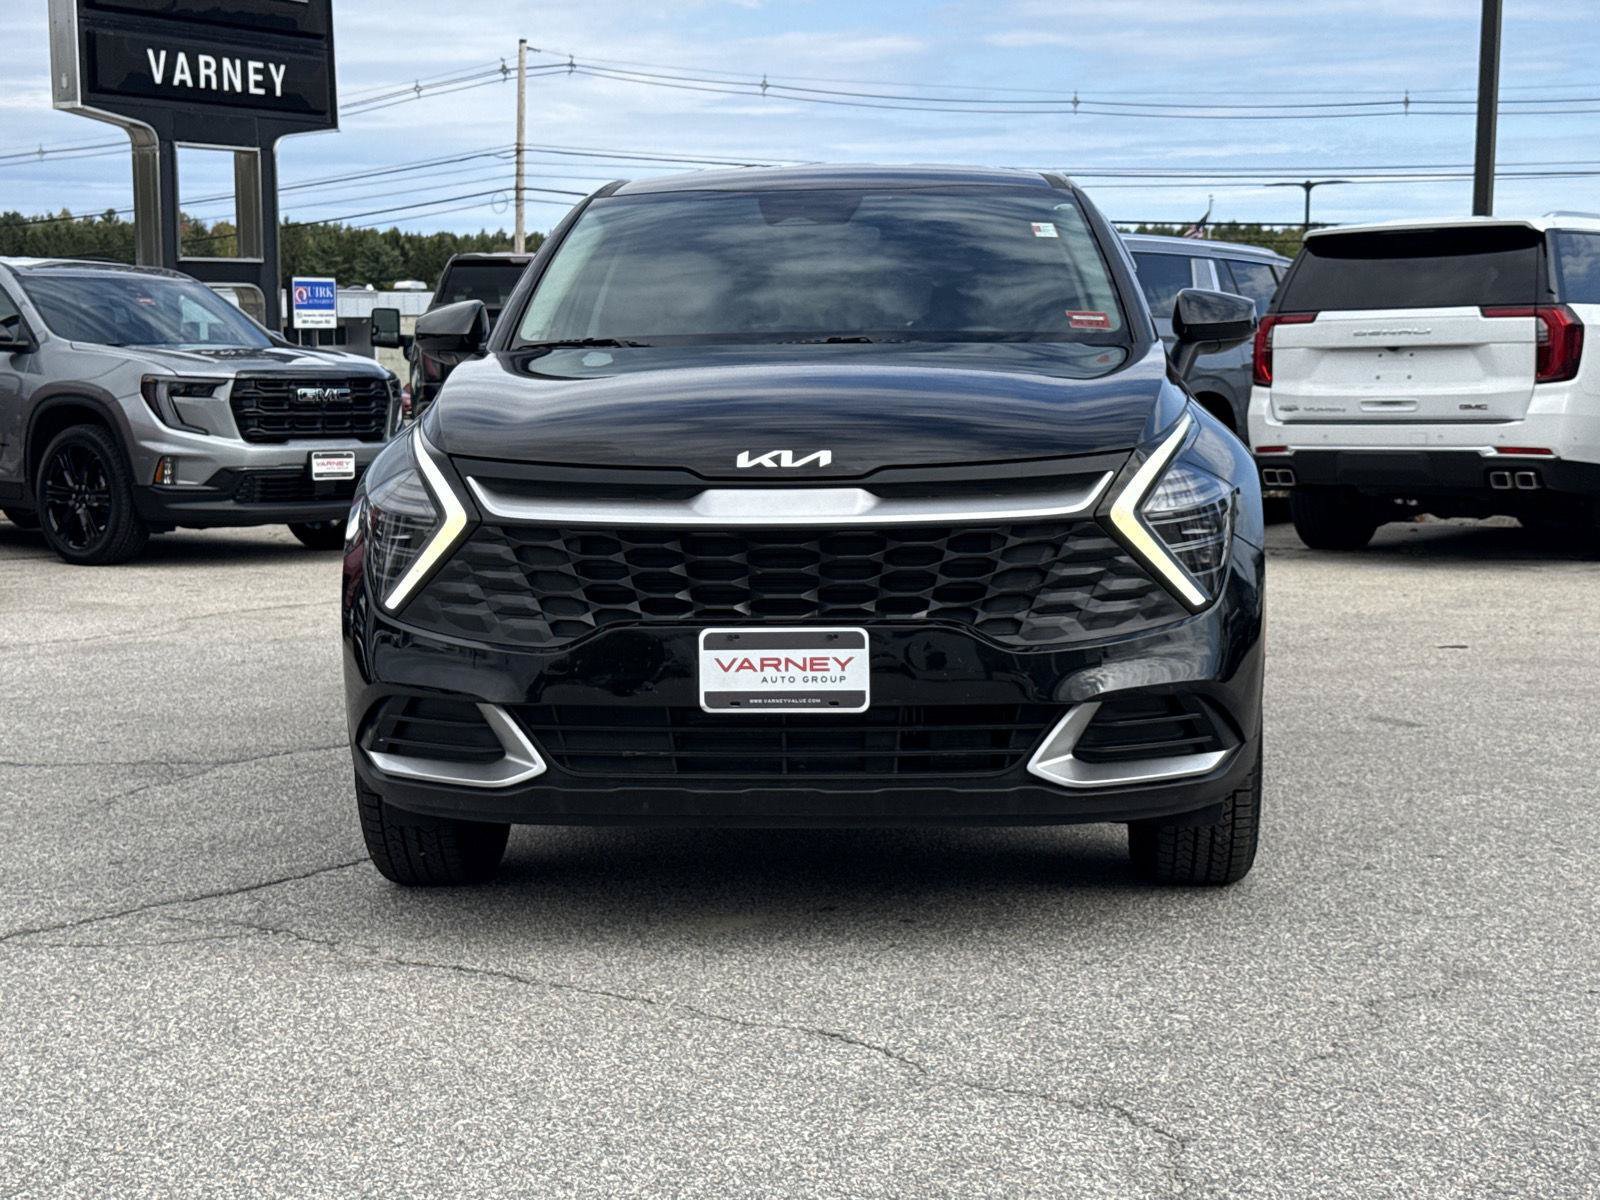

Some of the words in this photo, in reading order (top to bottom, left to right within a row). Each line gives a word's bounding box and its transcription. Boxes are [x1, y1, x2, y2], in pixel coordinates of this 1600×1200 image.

[147, 48, 287, 97] VARNEY
[295, 286, 334, 304] QUIRK
[1353, 327, 1432, 337] DENALI
[297, 387, 351, 402] GMC
[736, 449, 832, 468] KIA
[714, 656, 855, 673] VARNEY
[761, 676, 796, 684] AUTO
[802, 676, 847, 684] GROUP
